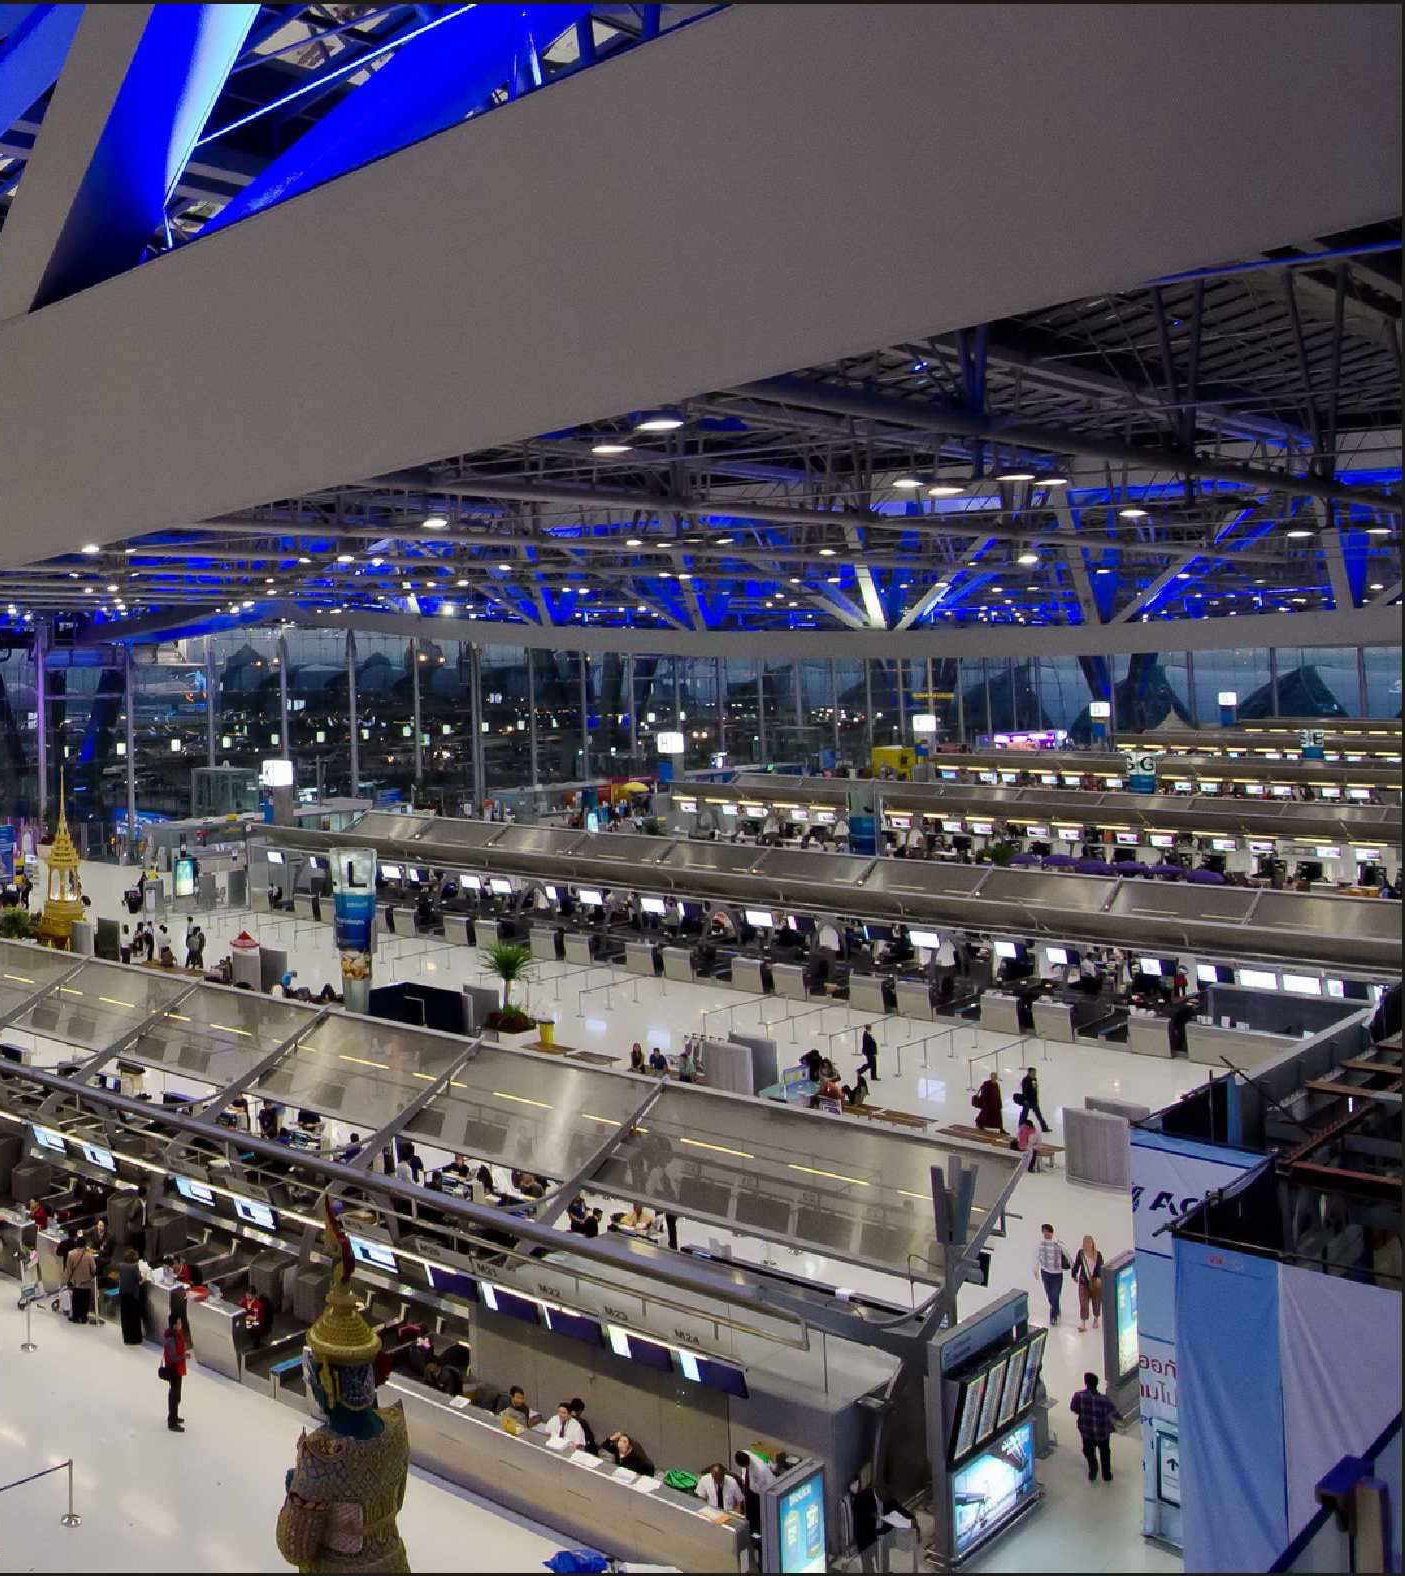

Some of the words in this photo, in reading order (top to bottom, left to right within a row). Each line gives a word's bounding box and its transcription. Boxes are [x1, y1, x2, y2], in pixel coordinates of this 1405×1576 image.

[1313, 732, 1324, 745] E
[1140, 756, 1154, 771] G
[347, 860, 368, 888] L
[537, 1282, 562, 1299] M22
[673, 1328, 700, 1346] M24
